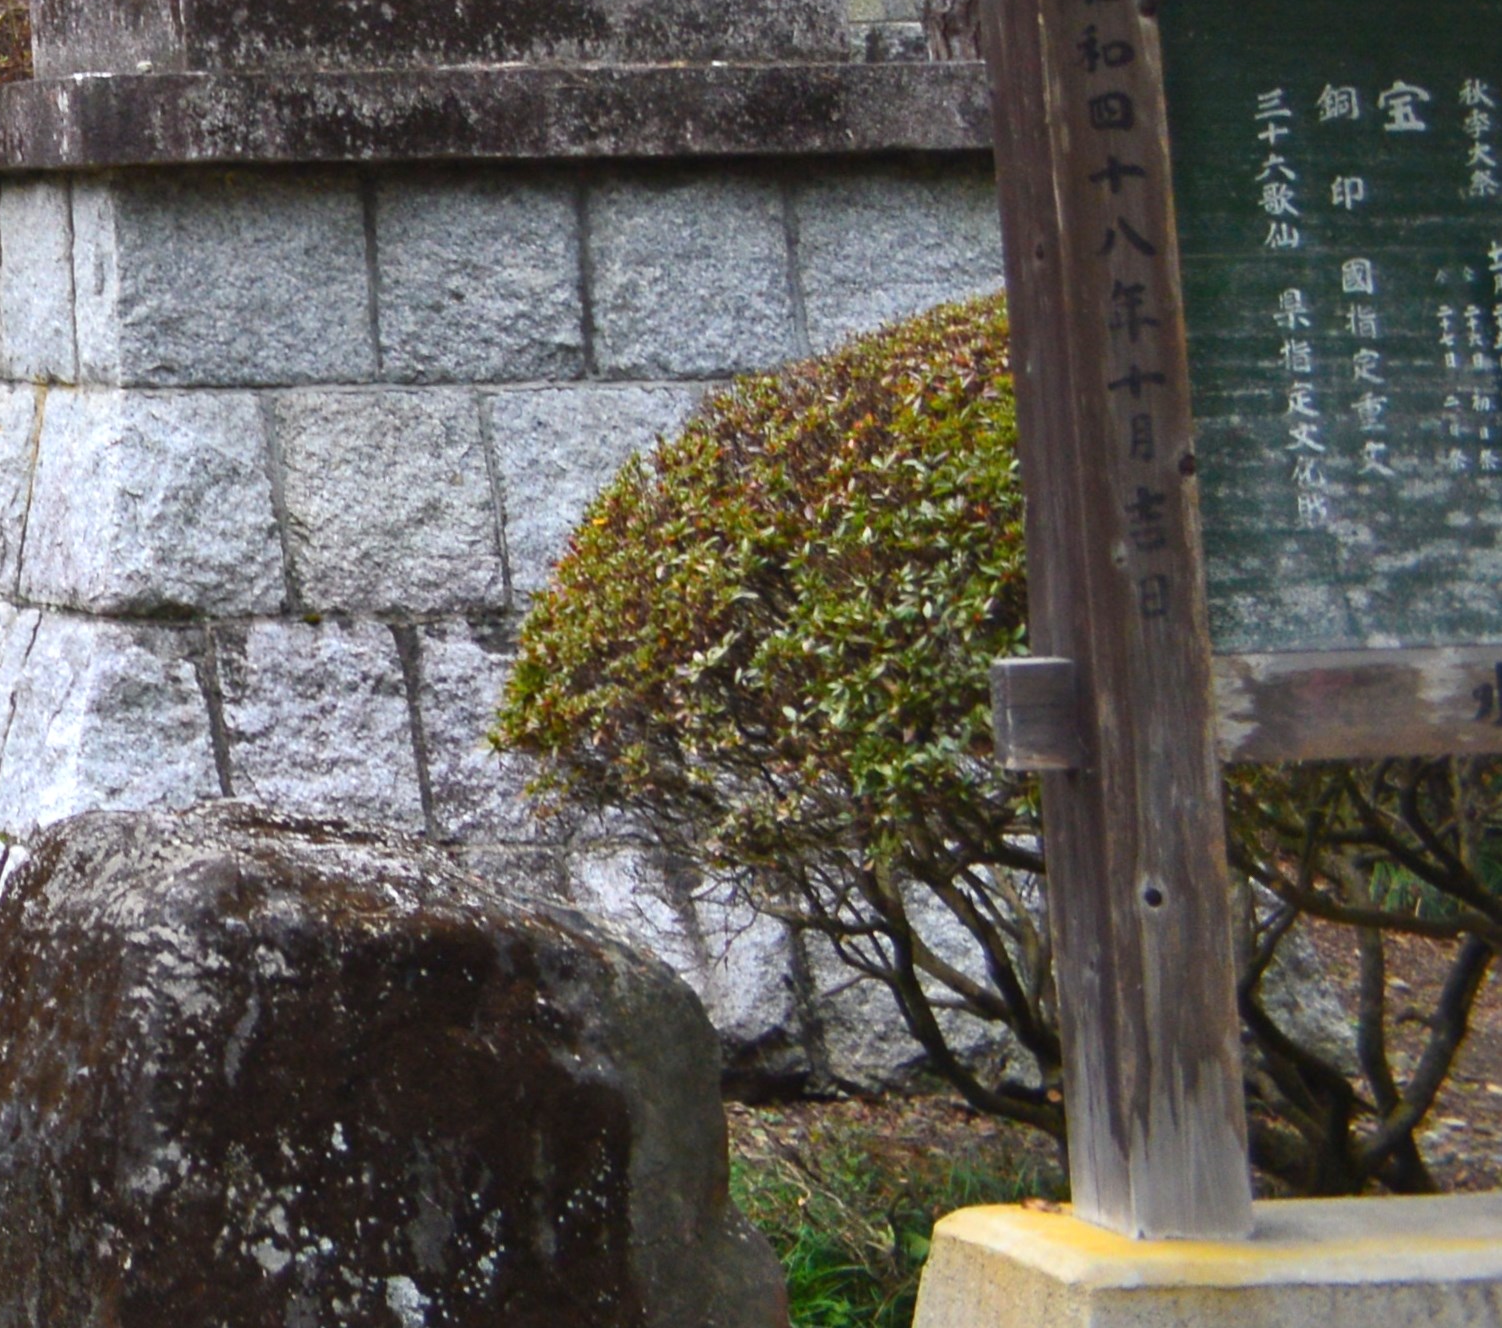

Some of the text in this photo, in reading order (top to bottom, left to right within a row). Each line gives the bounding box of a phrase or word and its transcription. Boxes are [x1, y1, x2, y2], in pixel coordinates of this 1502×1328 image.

[1254, 87, 1300, 249] 三十六歌仙
